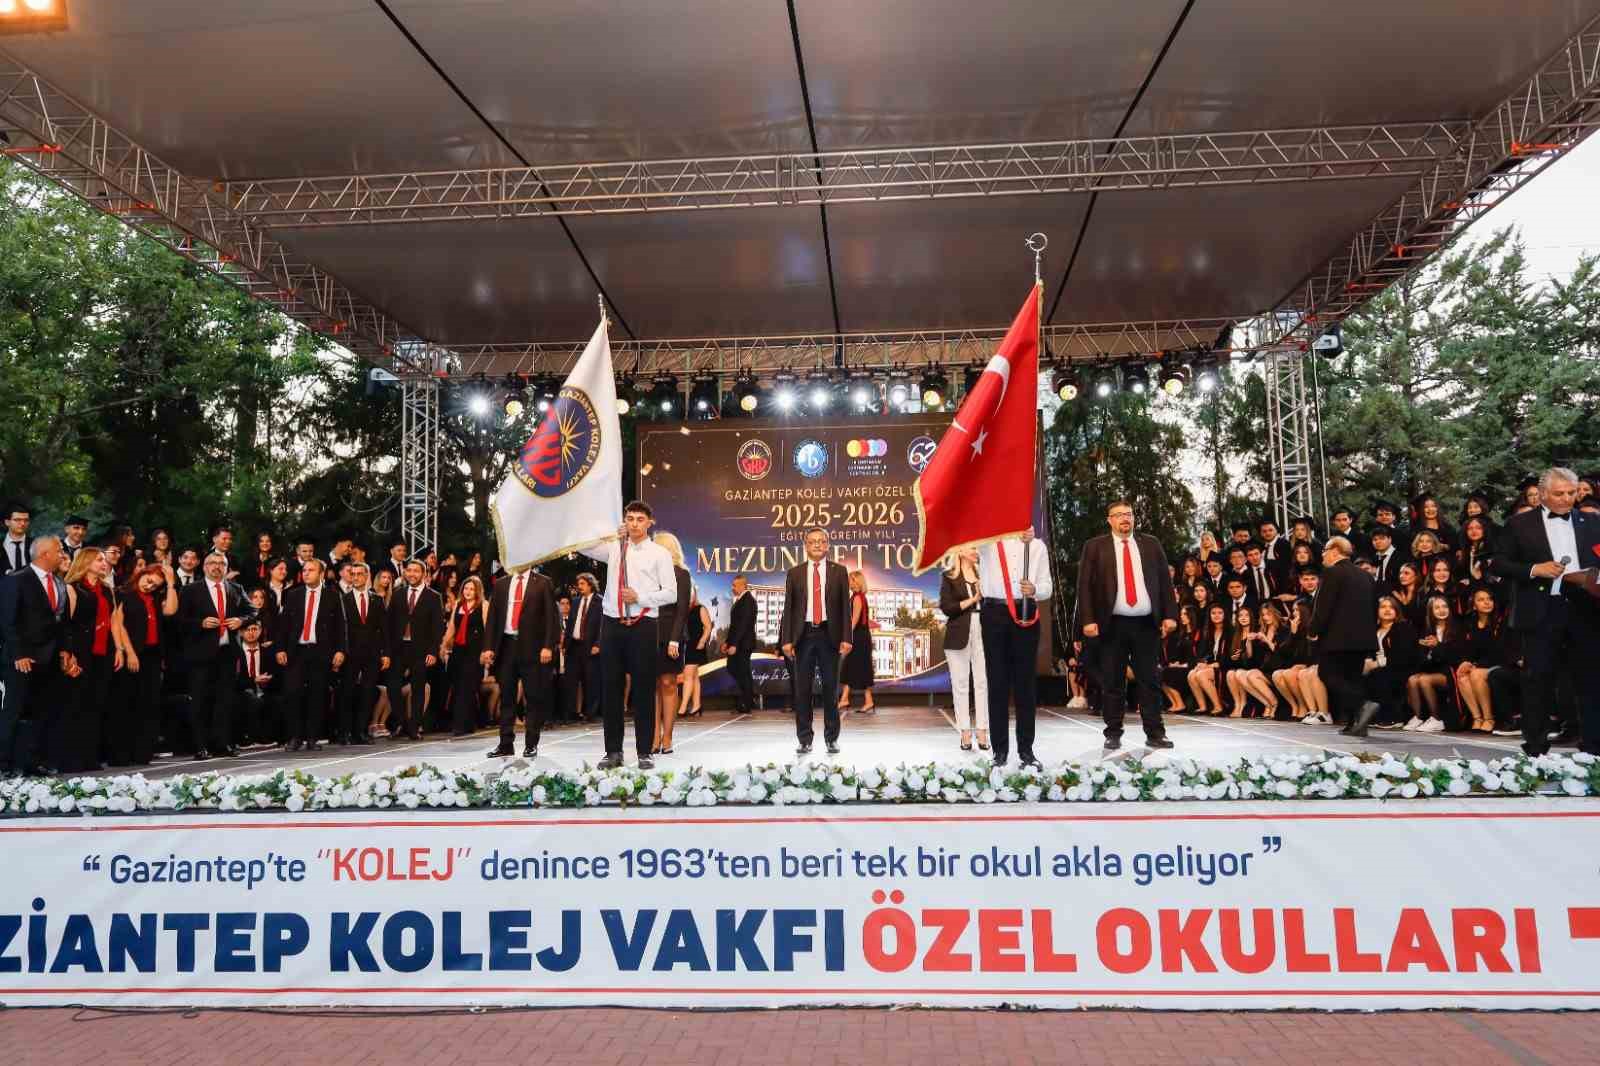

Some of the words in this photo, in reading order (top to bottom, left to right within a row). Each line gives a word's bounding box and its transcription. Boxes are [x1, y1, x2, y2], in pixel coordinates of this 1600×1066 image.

[725, 487, 793, 501] GAZİANTEP
[797, 487, 833, 499] KOLEJ
[837, 486, 872, 498] VAKFI
[771, 501, 904, 528] 2025-2026
[697, 544, 868, 573] MEZUNET
[481, 850, 609, 880] denince
[619, 848, 770, 878] 1963'ten
[781, 847, 841, 877] beri
[852, 846, 907, 877] tek
[918, 846, 960, 877] bir
[971, 846, 1041, 877] okul
[1053, 846, 1121, 877] akla
[330, 910, 581, 973] KOLEJ
[600, 909, 844, 972] VAKFI
[863, 890, 1077, 973] ÖZEL
[1096, 908, 1541, 973] OKULLARI
